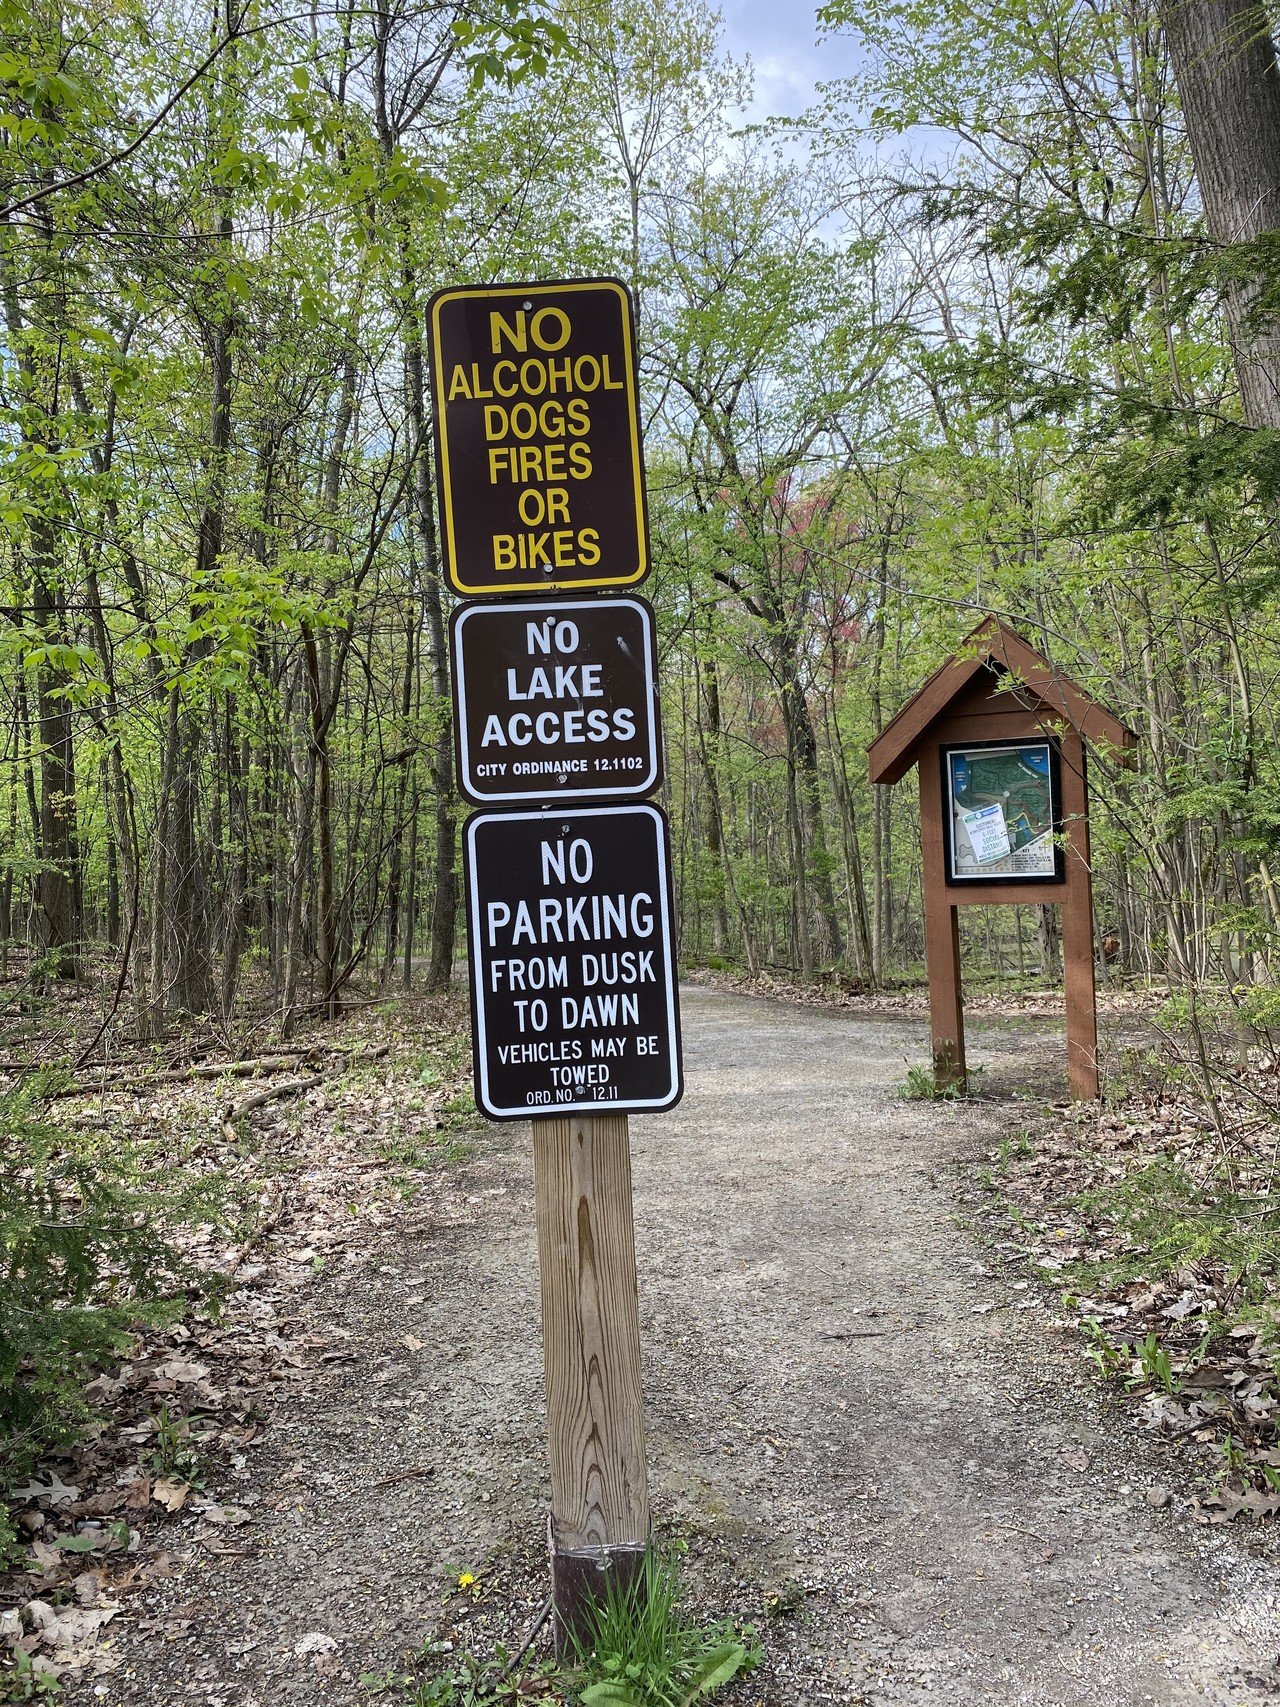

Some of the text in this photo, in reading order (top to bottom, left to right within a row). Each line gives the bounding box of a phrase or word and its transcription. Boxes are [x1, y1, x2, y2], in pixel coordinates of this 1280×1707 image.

[489, 307, 572, 354] NO
[448, 354, 624, 401] ALCOHOL
[484, 398, 591, 441] DOGS
[488, 442, 593, 484] FIRES
[518, 488, 571, 526] OR
[492, 528, 601, 571] BIKES
[526, 620, 580, 655] NO
[507, 664, 604, 700] LAKE
[480, 708, 636, 747] ACCESS
[476, 757, 643, 777] CITY ORDINANCE 12.1102
[540, 838, 593, 885] NO
[487, 892, 654, 947] PARKING
[491, 950, 657, 993] FROM DUSK
[513, 993, 640, 1032] TO DAWN
[498, 1035, 659, 1065] VEHICLES MAY BE
[550, 1064, 610, 1086] TOWED
[526, 1086, 618, 1105] ORD. NO. 12.11
